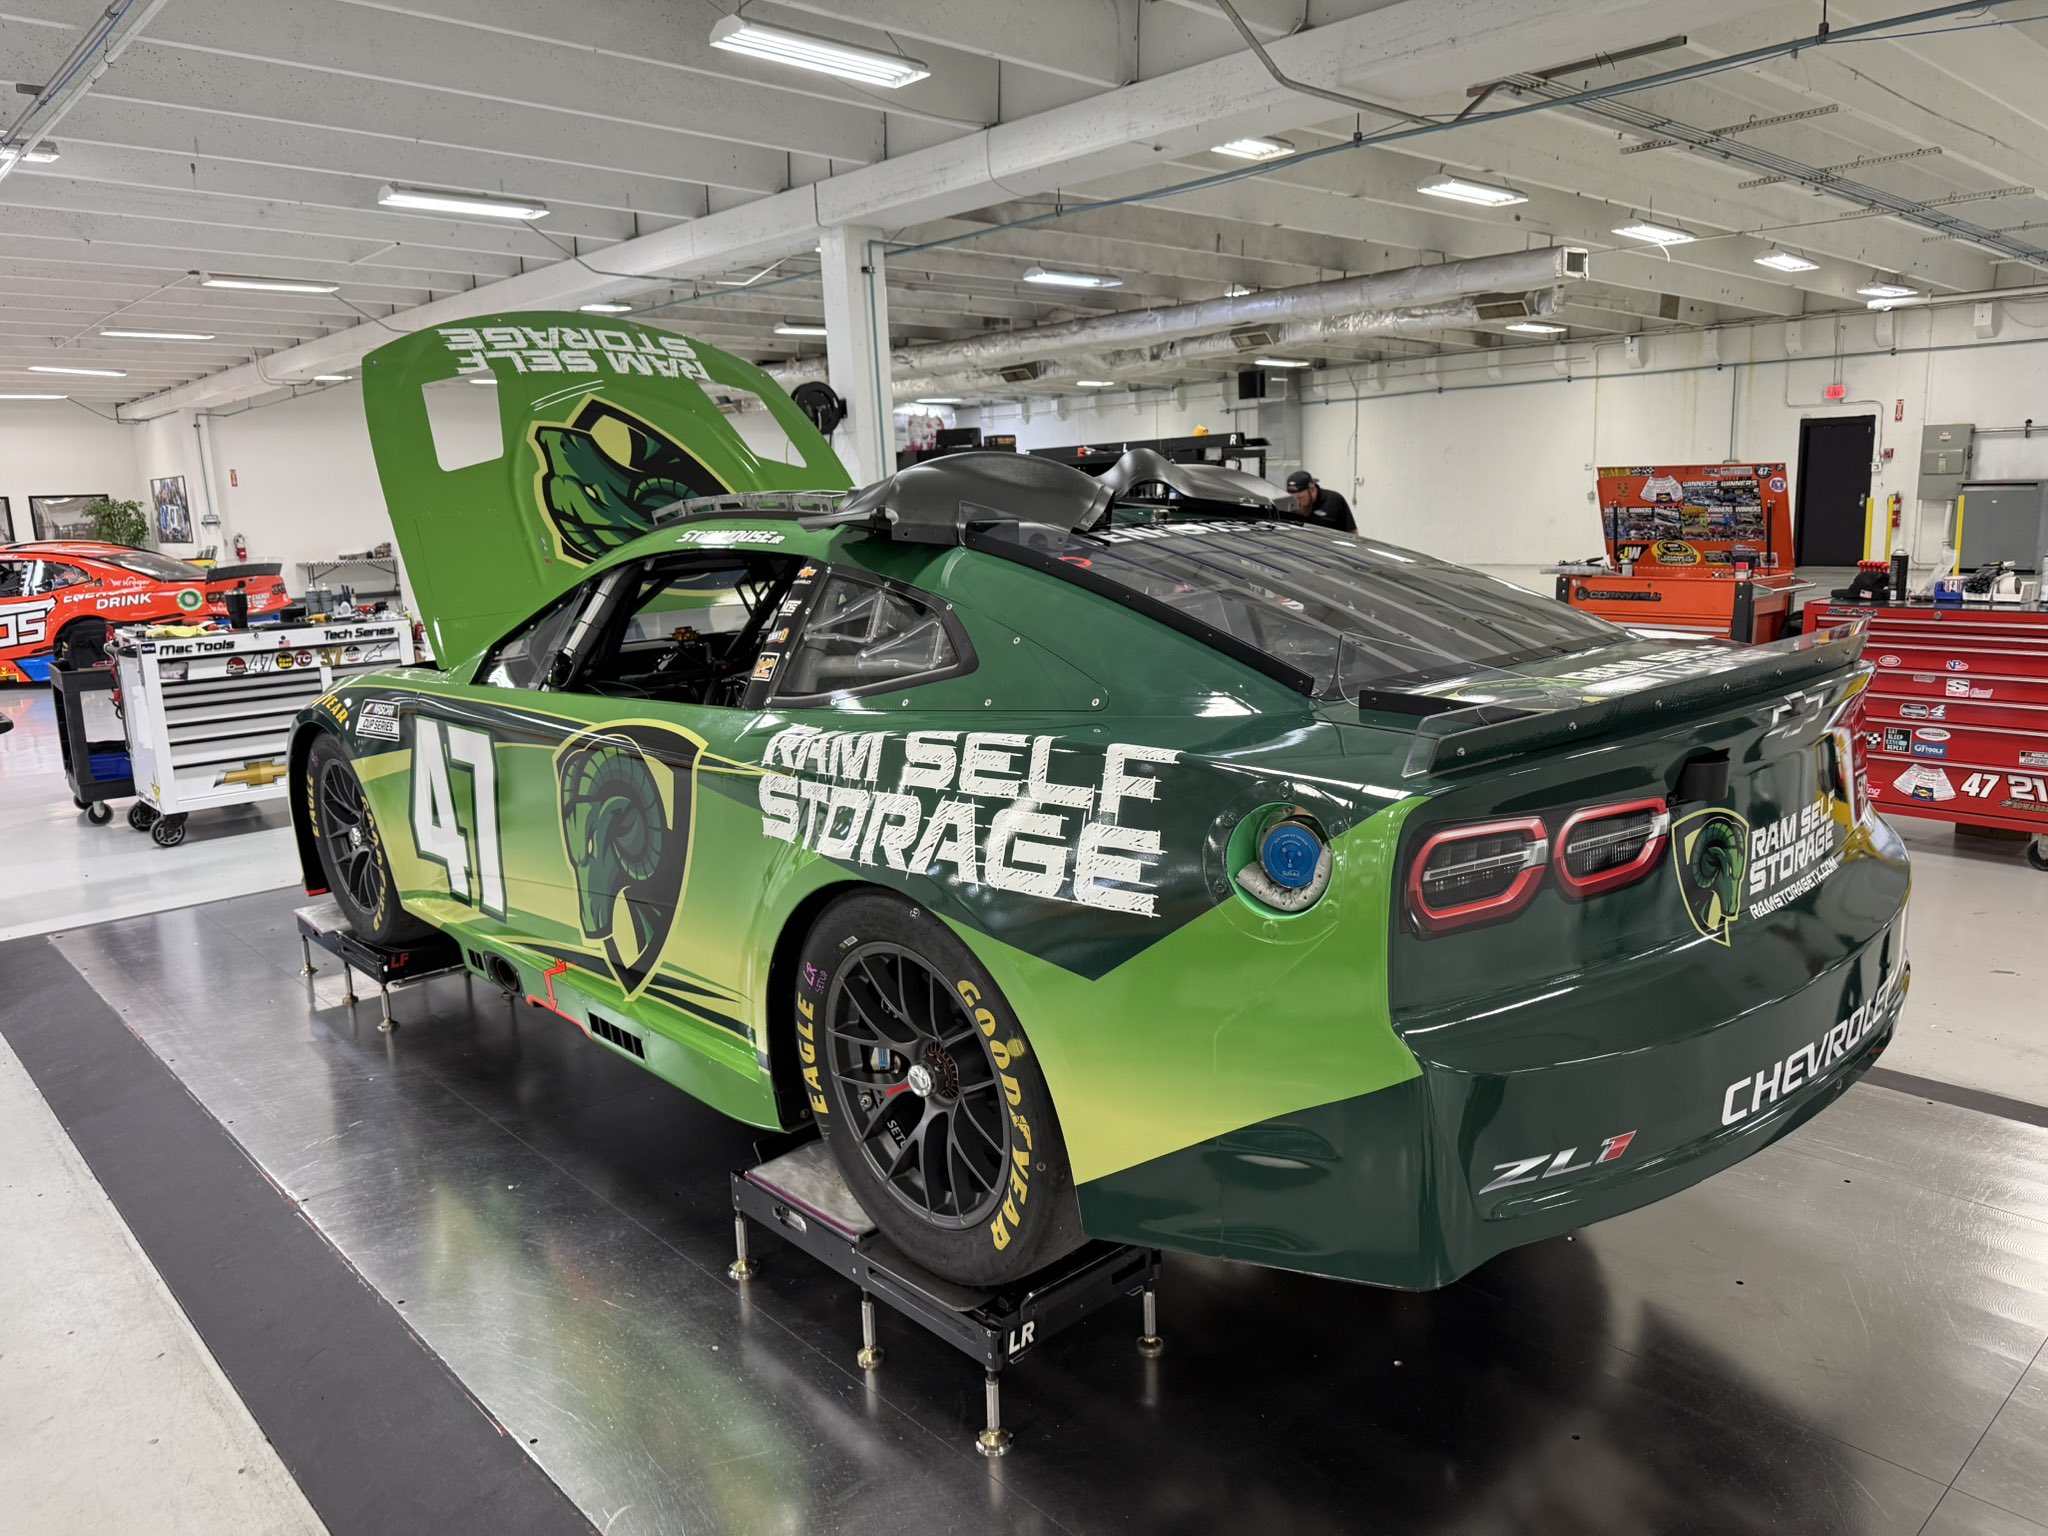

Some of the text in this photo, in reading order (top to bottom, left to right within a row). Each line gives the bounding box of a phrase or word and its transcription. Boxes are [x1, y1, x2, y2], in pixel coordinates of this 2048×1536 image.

[437, 325, 700, 358] STORAGE
[455, 348, 713, 380] RAM SELF
[1229, 434, 1237, 446] R
[1757, 467, 1769, 475] 47
[1655, 507, 1680, 519] WINNERS
[675, 529, 780, 545] STENHOUSE
[1620, 547, 1641, 559] JW
[96, 592, 152, 610] DRINK
[324, 627, 396, 641] Tech Series
[160, 645, 193, 656] Mac
[194, 639, 235, 652] Tools
[317, 648, 342, 667] 37
[249, 653, 274, 673] 47
[371, 703, 395, 717] NASCAR
[362, 719, 395, 732] CUP SERIES
[760, 723, 1188, 825] RAM SELF
[1960, 773, 2001, 799] 47
[2006, 774, 2048, 803] 21
[306, 774, 320, 838] EAGLE
[411, 716, 508, 924] 47
[1750, 812, 1798, 862] RAM
[1800, 788, 1835, 838] SELF
[758, 774, 1168, 917] STORAGE
[1749, 818, 1835, 897] STORAGE
[1748, 855, 1840, 920] RAMSTORAGETX.COM
[390, 953, 410, 968] LF
[802, 961, 818, 987] LR
[815, 969, 829, 994] SETUP
[795, 991, 831, 1115] EAGLE
[1721, 968, 1896, 1126] CHEVROLET
[956, 979, 1036, 1252] GOODYEAR
[1478, 1130, 1637, 1196] ZL1
[1008, 1320, 1036, 1354] LR
